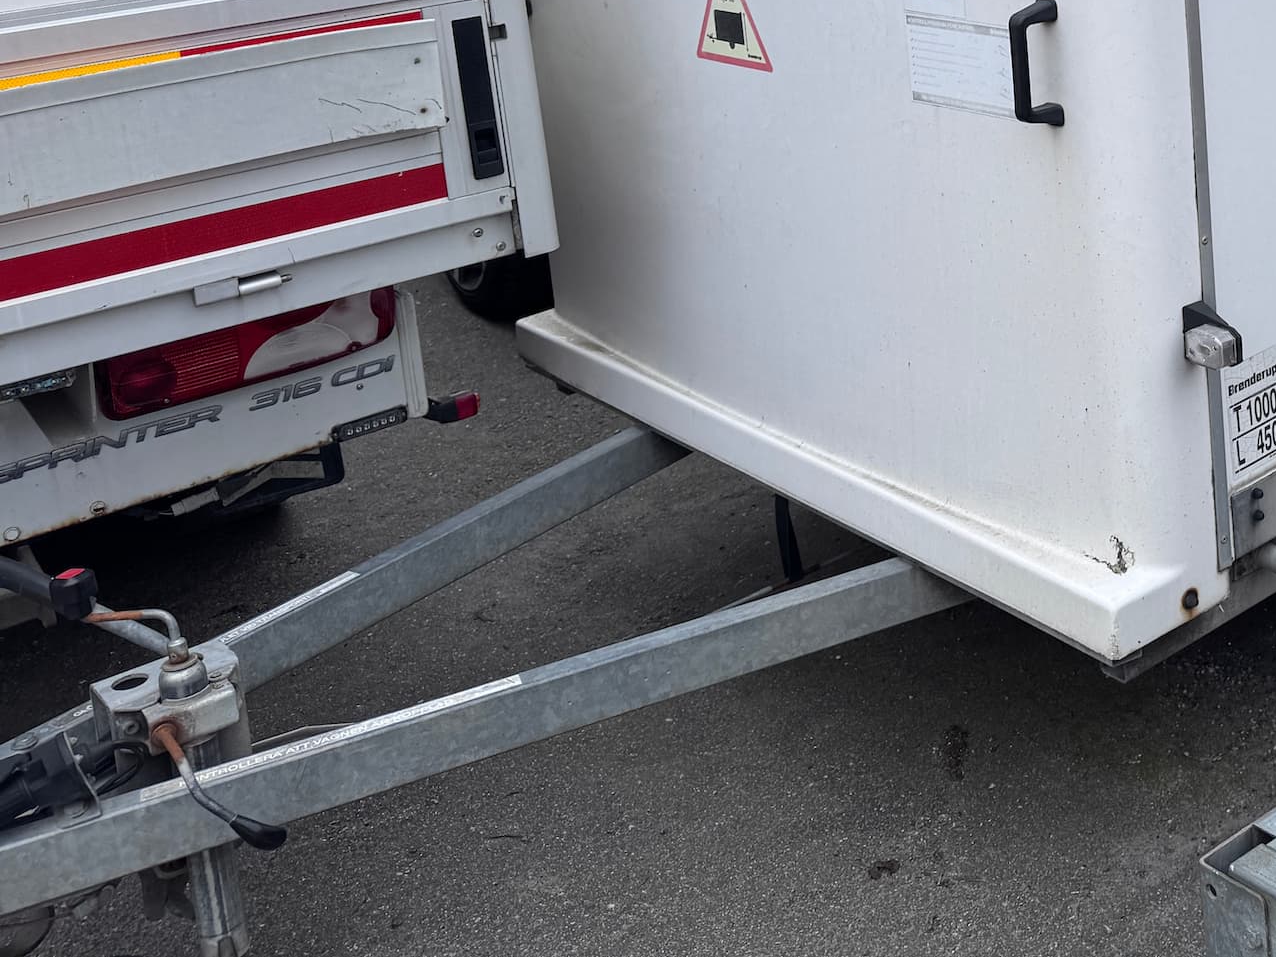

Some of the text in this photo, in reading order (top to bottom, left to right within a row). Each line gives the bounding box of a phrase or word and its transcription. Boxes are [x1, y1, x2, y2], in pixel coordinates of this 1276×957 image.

[249, 376, 323, 412] 316
[331, 354, 396, 387] CDI
[1233, 405, 1242, 433] T
[1236, 440, 1246, 466] L
